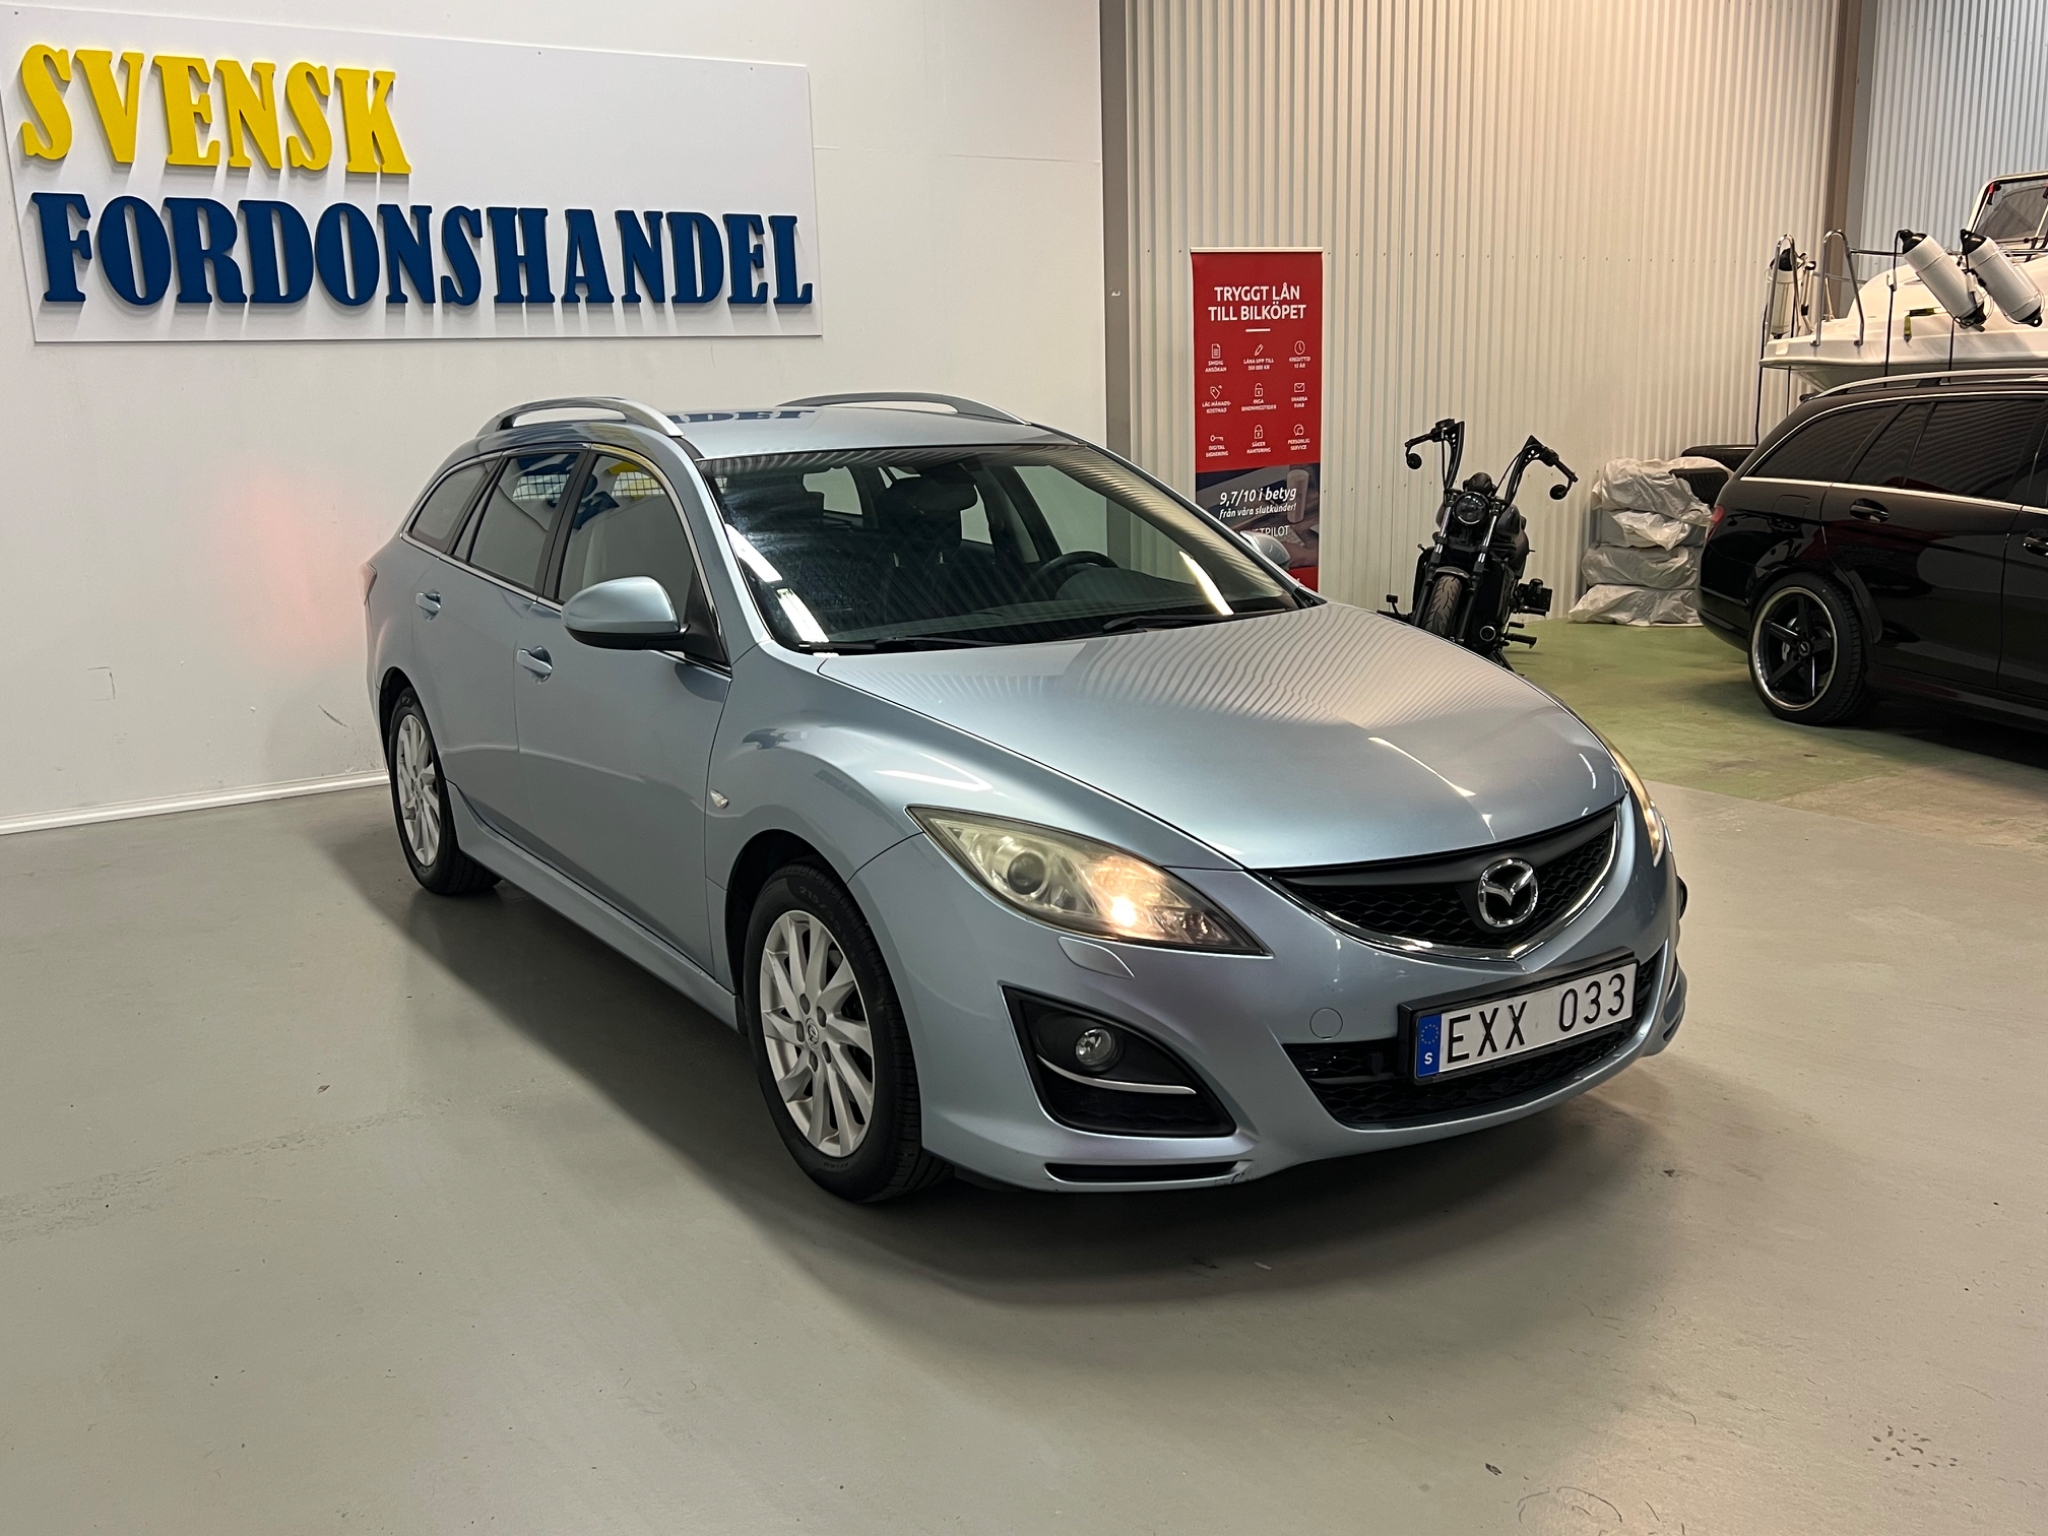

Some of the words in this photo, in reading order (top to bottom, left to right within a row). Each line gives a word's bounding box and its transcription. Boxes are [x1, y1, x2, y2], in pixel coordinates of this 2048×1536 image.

[20, 43, 412, 175] SVENSK
[31, 191, 814, 307] FORDONSHANDEL
[1214, 286, 1269, 301] TRYGGT
[1272, 282, 1300, 300] LÅN
[1208, 306, 1238, 321] TILL
[1241, 301, 1307, 320] BILKÖPET
[1220, 489, 1257, 507] 9,7/10
[1258, 488, 1264, 501] i
[1265, 487, 1297, 501] betyg
[1219, 508, 1236, 520] från
[1237, 507, 1254, 516] våra
[1447, 1001, 1528, 1063] EXX
[1558, 973, 1626, 1032] 033
[1424, 1052, 1433, 1065] S
